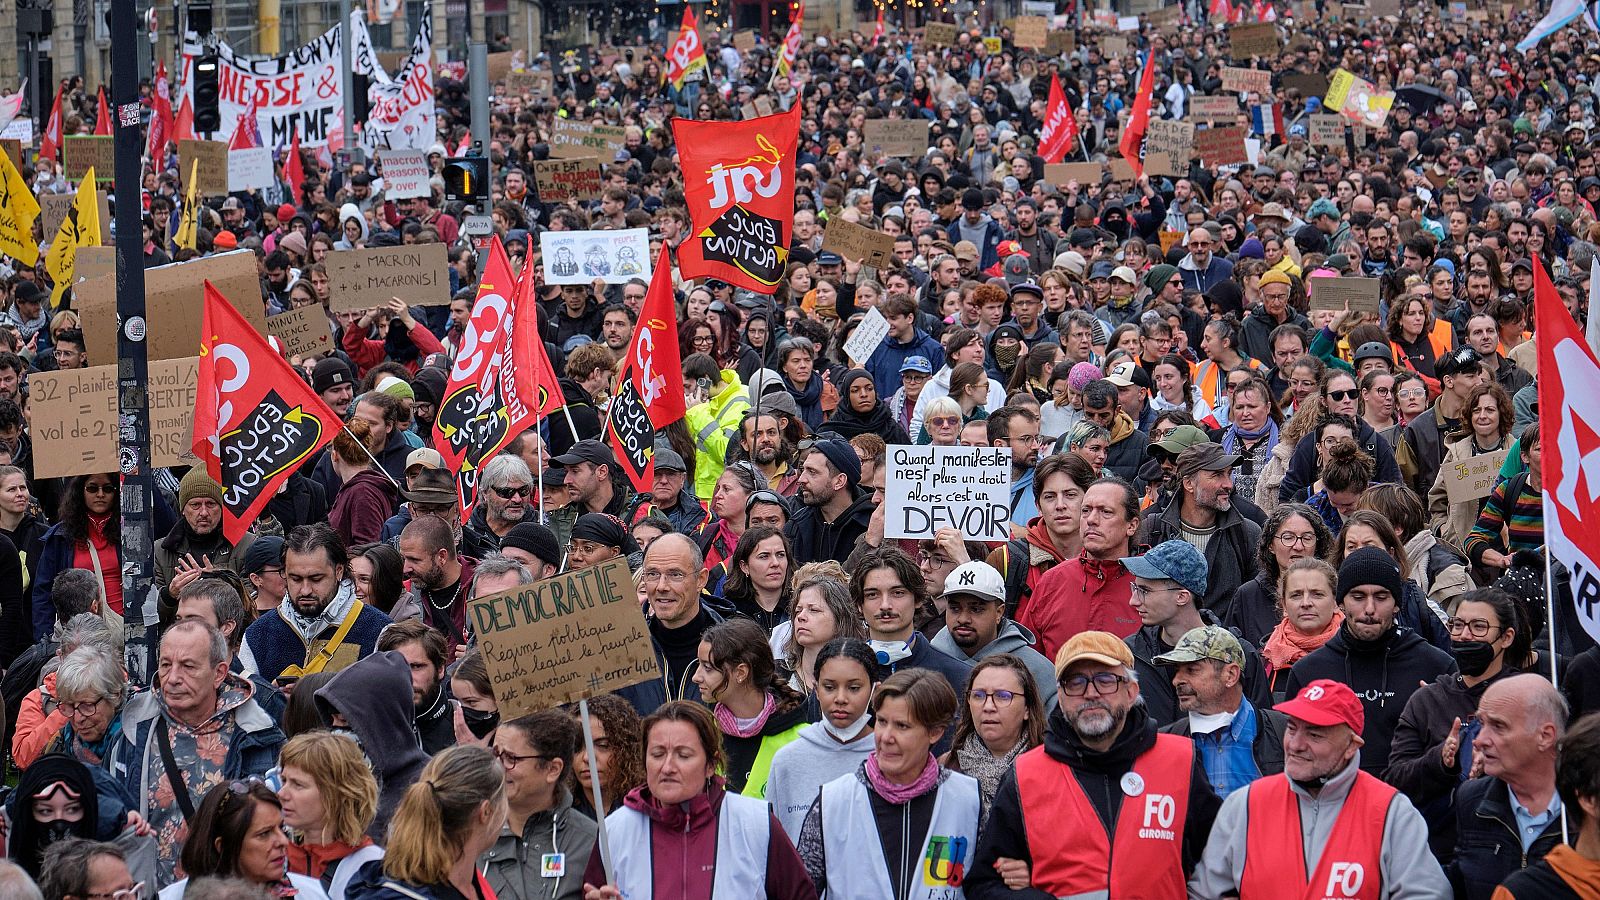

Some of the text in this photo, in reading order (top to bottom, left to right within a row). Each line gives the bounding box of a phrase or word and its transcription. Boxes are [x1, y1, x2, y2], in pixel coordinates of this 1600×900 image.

[317, 65, 339, 99] &
[383, 156, 423, 167] macron
[384, 167, 428, 179] season's
[396, 181, 418, 192] over
[367, 253, 421, 268] MACRON
[267, 311, 305, 332] MINUTE
[33, 378, 62, 403] 32
[68, 371, 118, 403] plainte
[156, 365, 181, 386] viol
[40, 420, 64, 441] vol
[70, 418, 88, 439] de
[93, 420, 107, 438] 2
[894, 447, 1011, 467] Quand manifester
[895, 465, 1007, 488] n'est plus un droit
[1455, 462, 1470, 481] Je
[907, 482, 990, 502] Alors c'est un
[902, 503, 1010, 538] DEVOIR
[483, 621, 617, 672] Régime politique
[494, 626, 644, 684] dans lequel le peuple
[500, 688, 519, 703] est
[634, 659, 658, 676] 404
[1303, 685, 1325, 701] FO
[1143, 793, 1176, 829] FO
[1138, 828, 1175, 841] GIRONDE
[1325, 861, 1365, 897] FO
